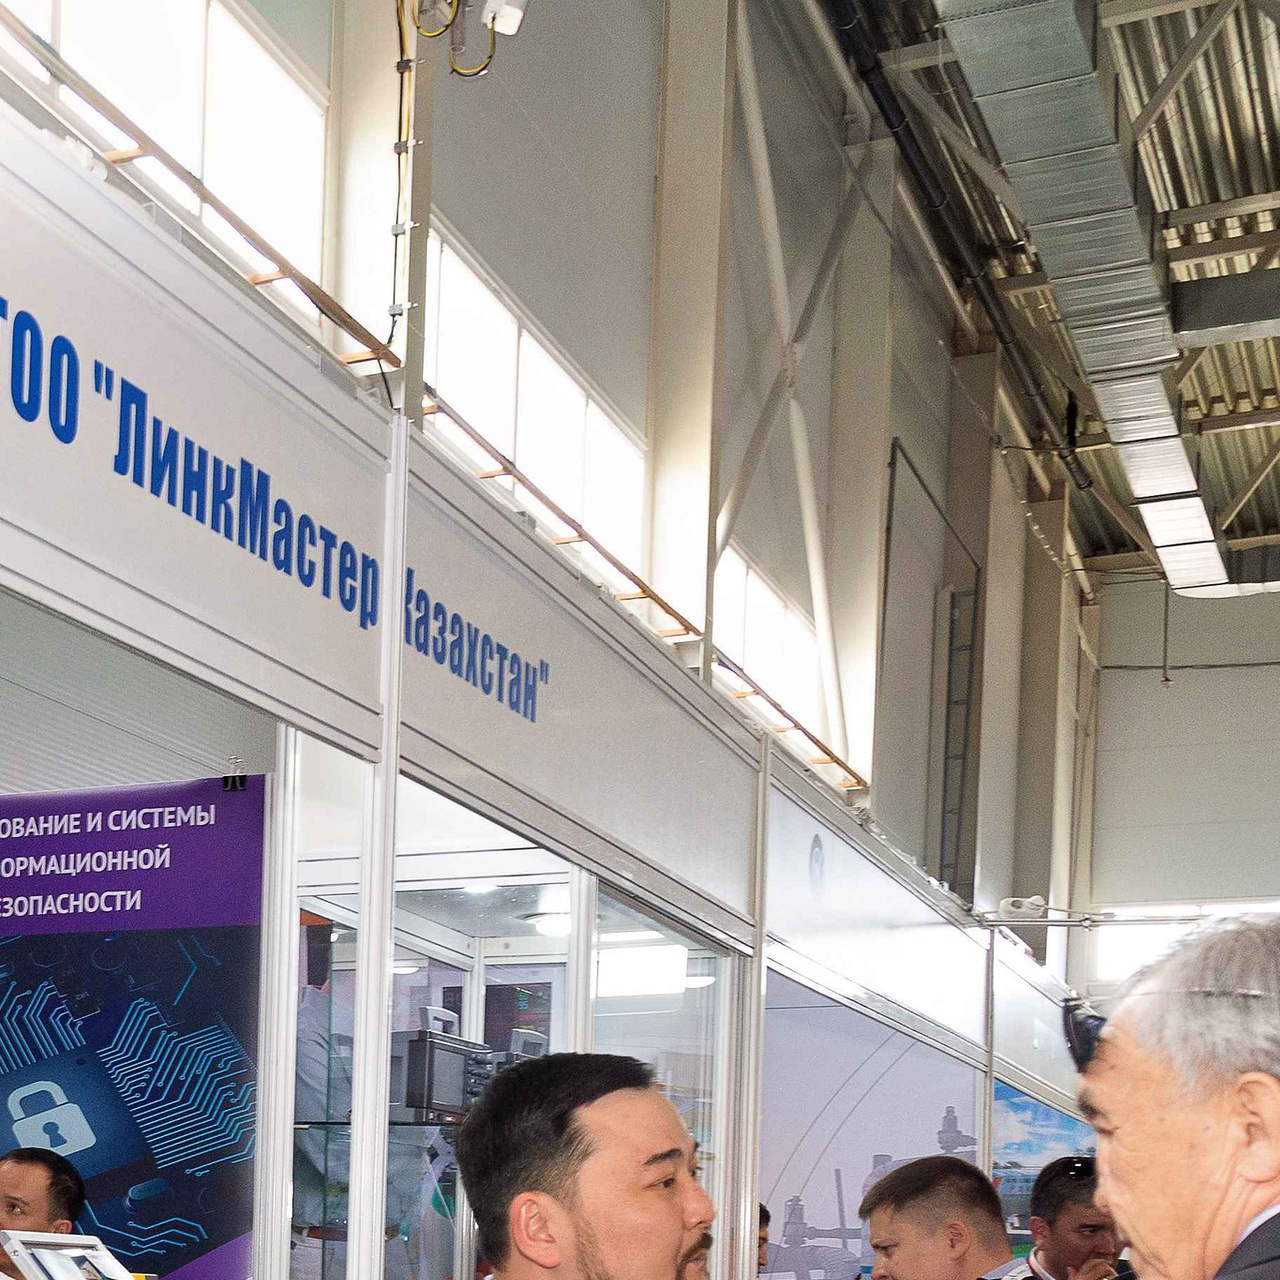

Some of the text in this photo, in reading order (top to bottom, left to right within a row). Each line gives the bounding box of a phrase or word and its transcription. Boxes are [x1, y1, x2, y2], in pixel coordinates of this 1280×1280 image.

[93, 359, 380, 630] "ЛинкМастер
[86, 811, 102, 833] И
[107, 804, 217, 831] СИСТЕМЫ
